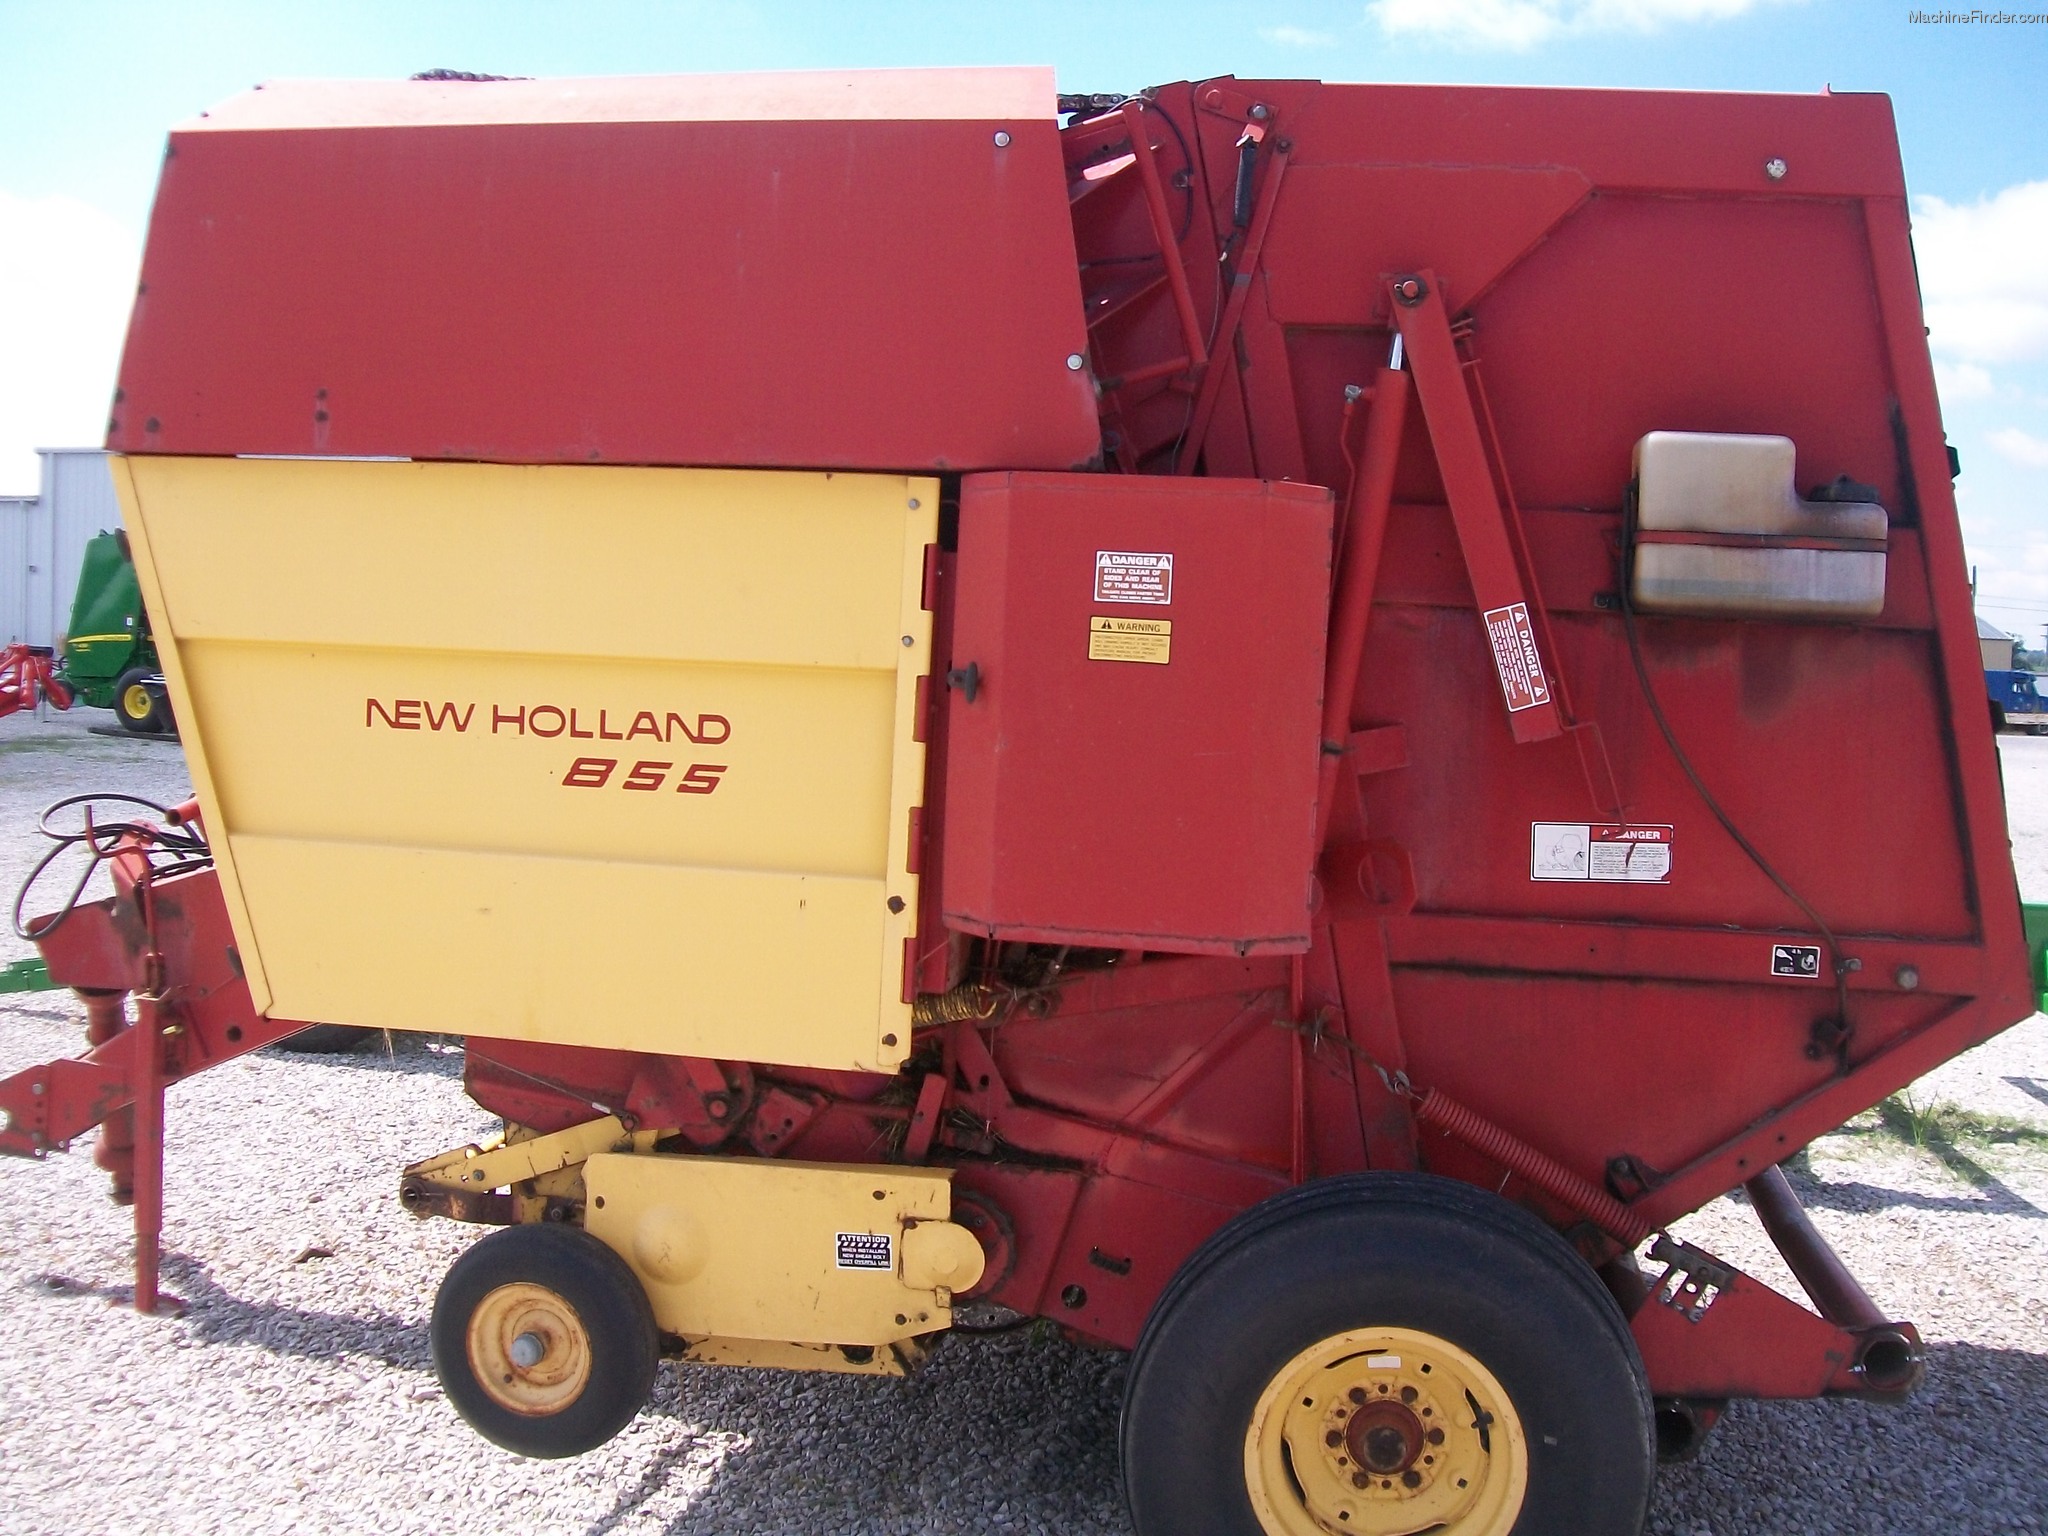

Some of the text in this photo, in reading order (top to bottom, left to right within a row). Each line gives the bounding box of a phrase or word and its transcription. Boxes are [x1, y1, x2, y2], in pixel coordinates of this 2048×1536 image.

[1112, 555, 1157, 566] DANGER
[1117, 622, 1161, 632] WARNING
[1520, 630, 1540, 677] DANGER
[366, 698, 731, 745] NEW HOLLAND
[561, 757, 728, 795] 855
[1615, 830, 1660, 839] ANGER
[840, 1235, 886, 1243] ATTENTION
